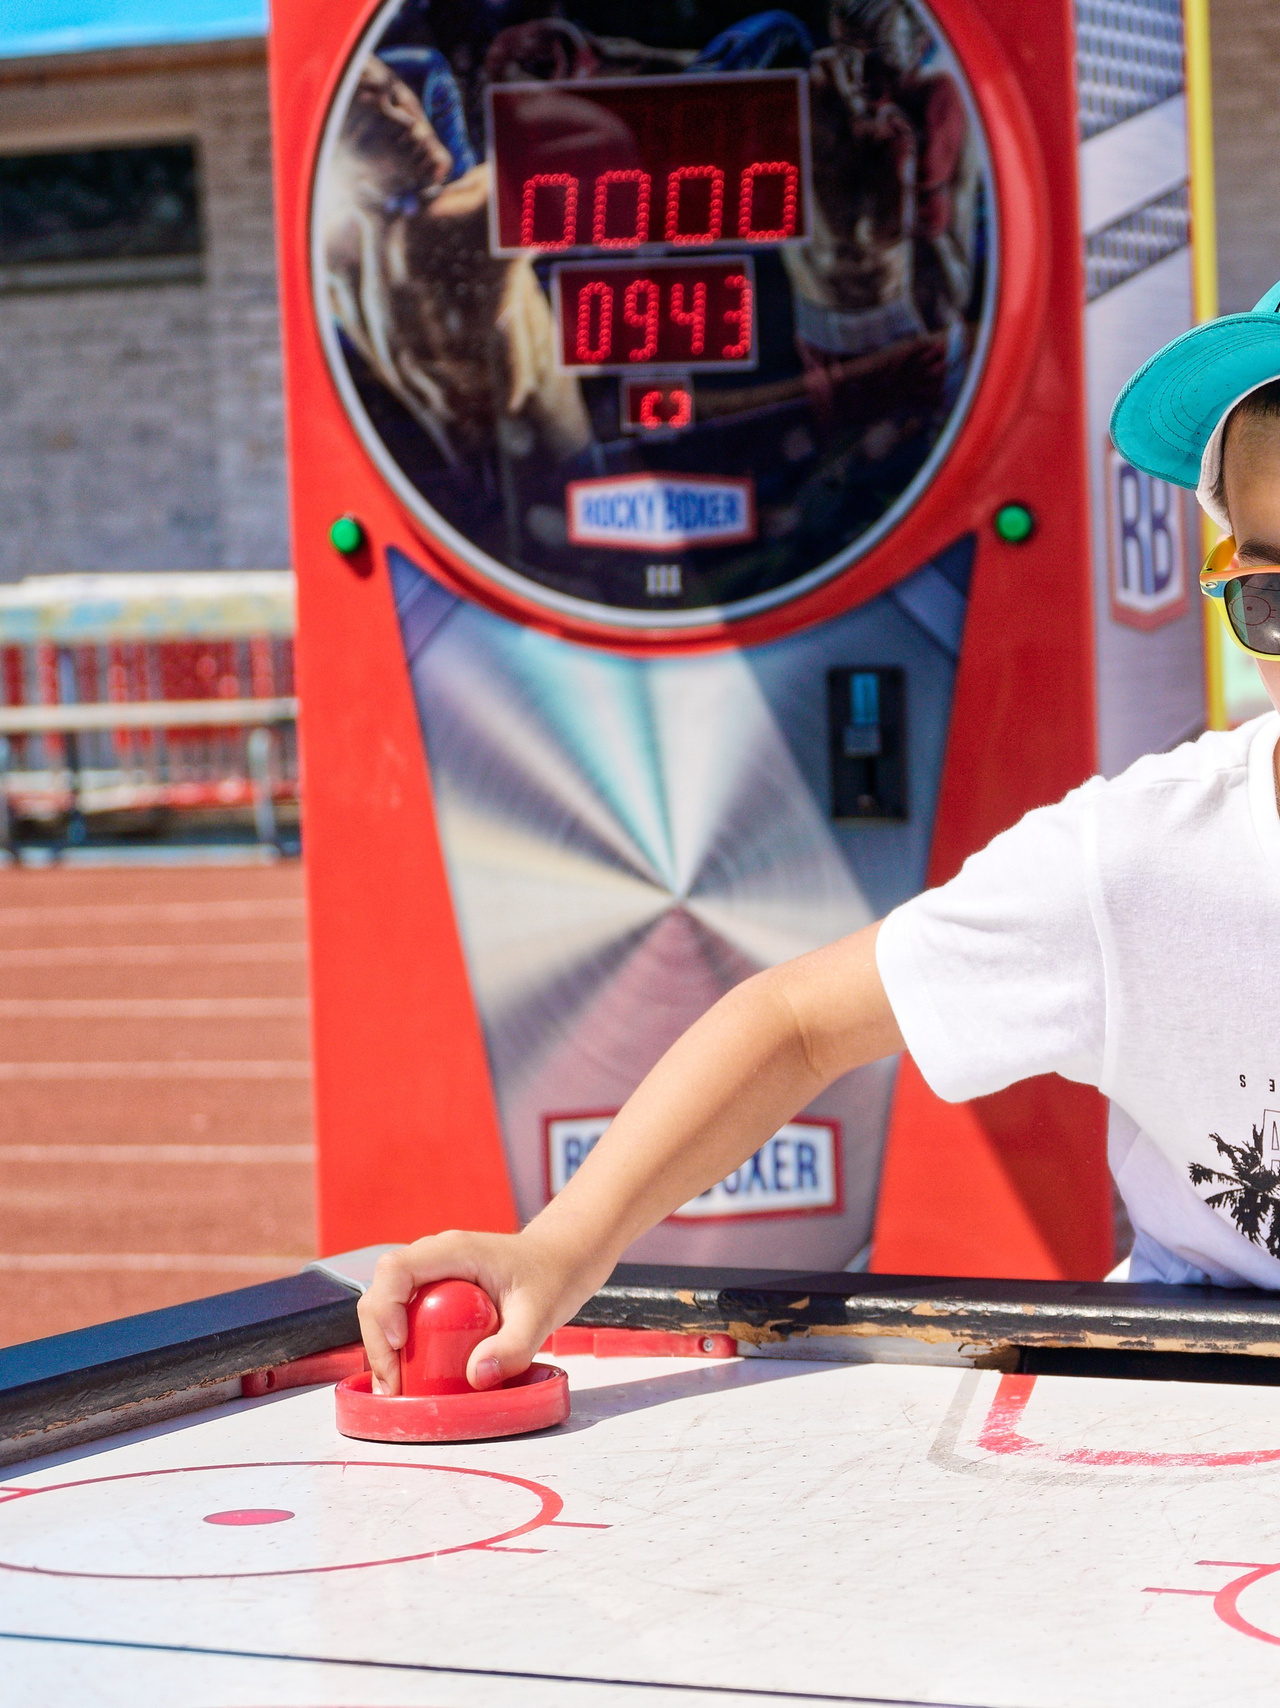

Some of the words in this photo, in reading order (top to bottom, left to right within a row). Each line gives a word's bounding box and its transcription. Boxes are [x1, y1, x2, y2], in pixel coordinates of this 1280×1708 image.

[521, 161, 798, 253] 0000
[577, 275, 753, 364] 0943
[1120, 462, 1174, 595] RB
[699, 1139, 819, 1197] XER
